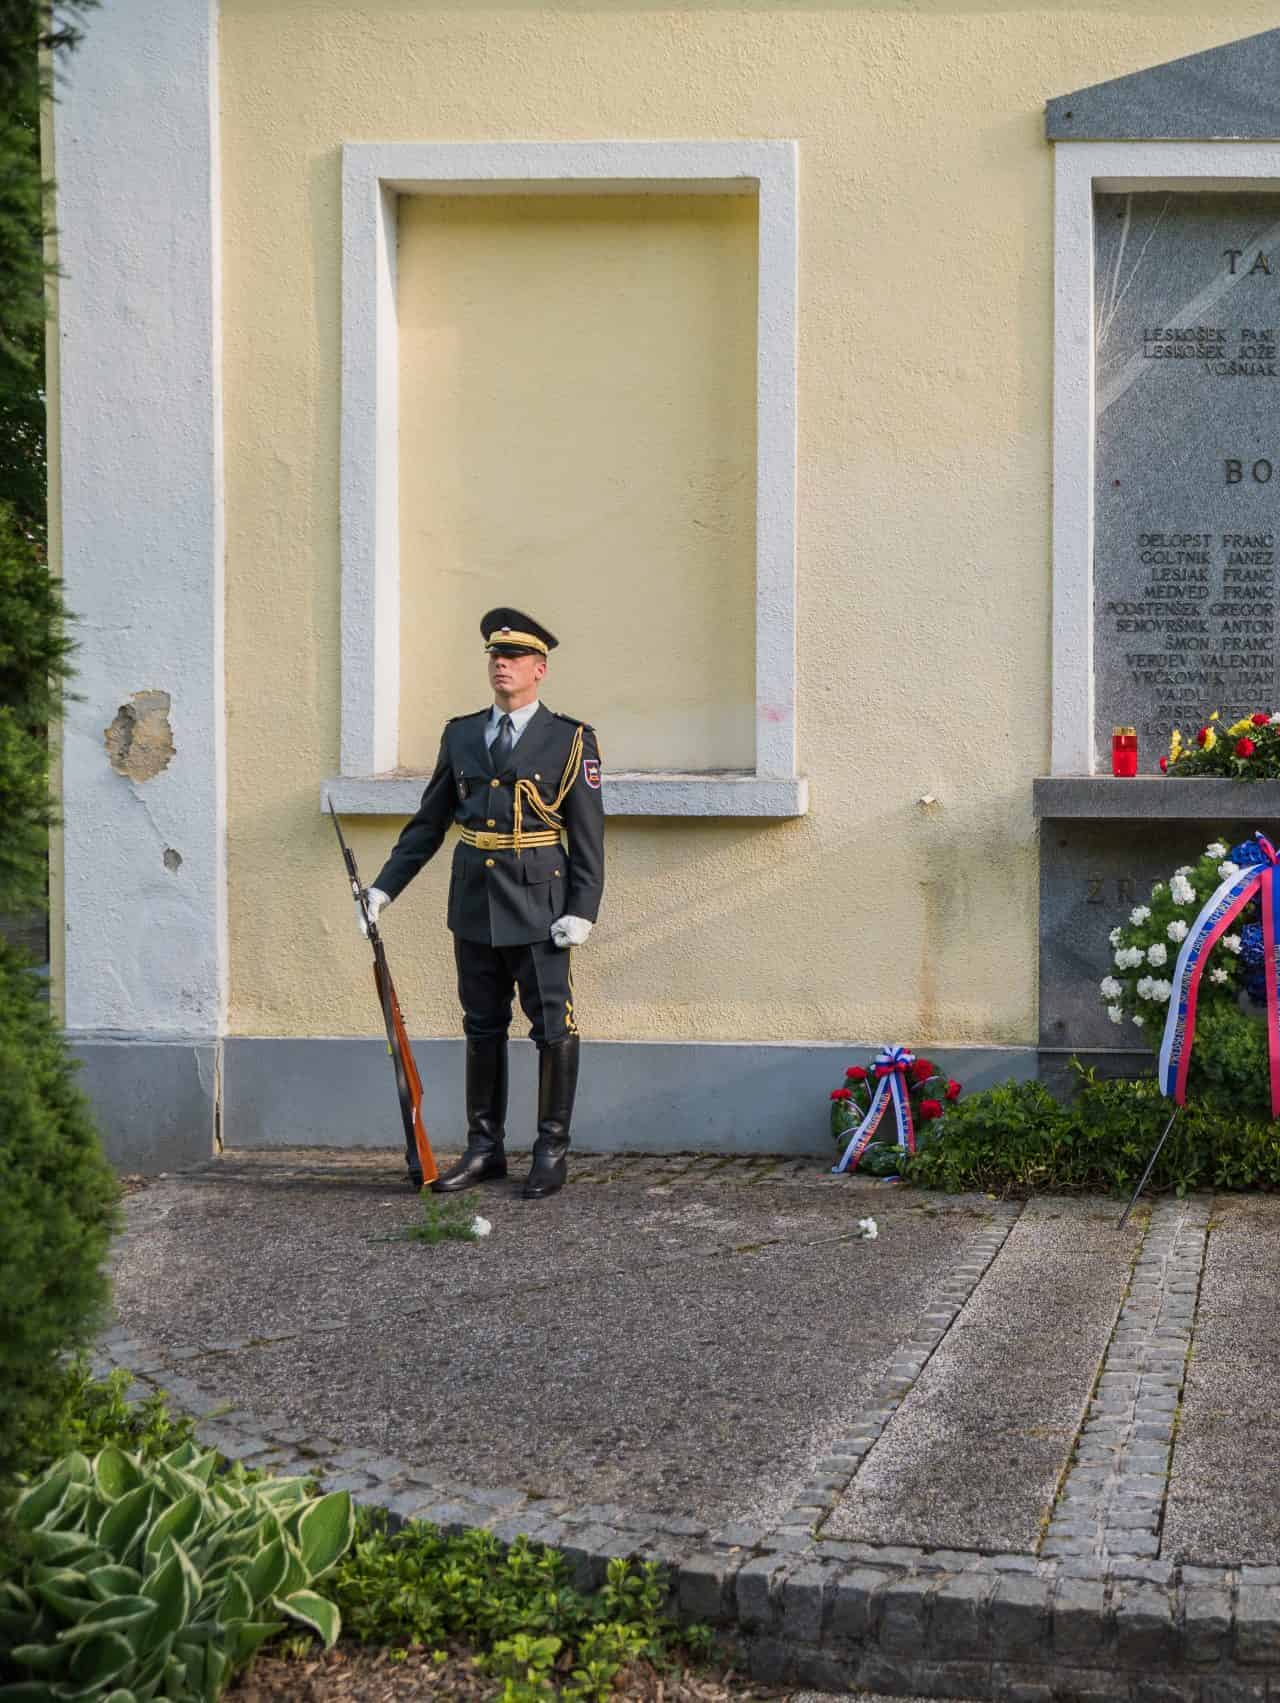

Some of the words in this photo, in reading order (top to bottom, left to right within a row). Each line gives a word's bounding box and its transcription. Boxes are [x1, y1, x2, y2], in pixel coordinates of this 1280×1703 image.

[1238, 343, 1276, 359] JOŽE
[1138, 534, 1211, 548] DELOPST
[1223, 534, 1274, 548] FRANC
[1228, 551, 1274, 565] JANEZ
[1152, 568, 1208, 582] LESJAK
[1223, 569, 1274, 582] FRANC
[1144, 585, 1209, 599] MEDVED
[1223, 586, 1274, 599] FRANC
[1210, 602, 1274, 616] GREGOR
[1221, 620, 1274, 633] ANTON
[1223, 637, 1274, 650] FRANC
[1200, 654, 1274, 668] VALENTIN
[1239, 672, 1274, 685] IVAN
